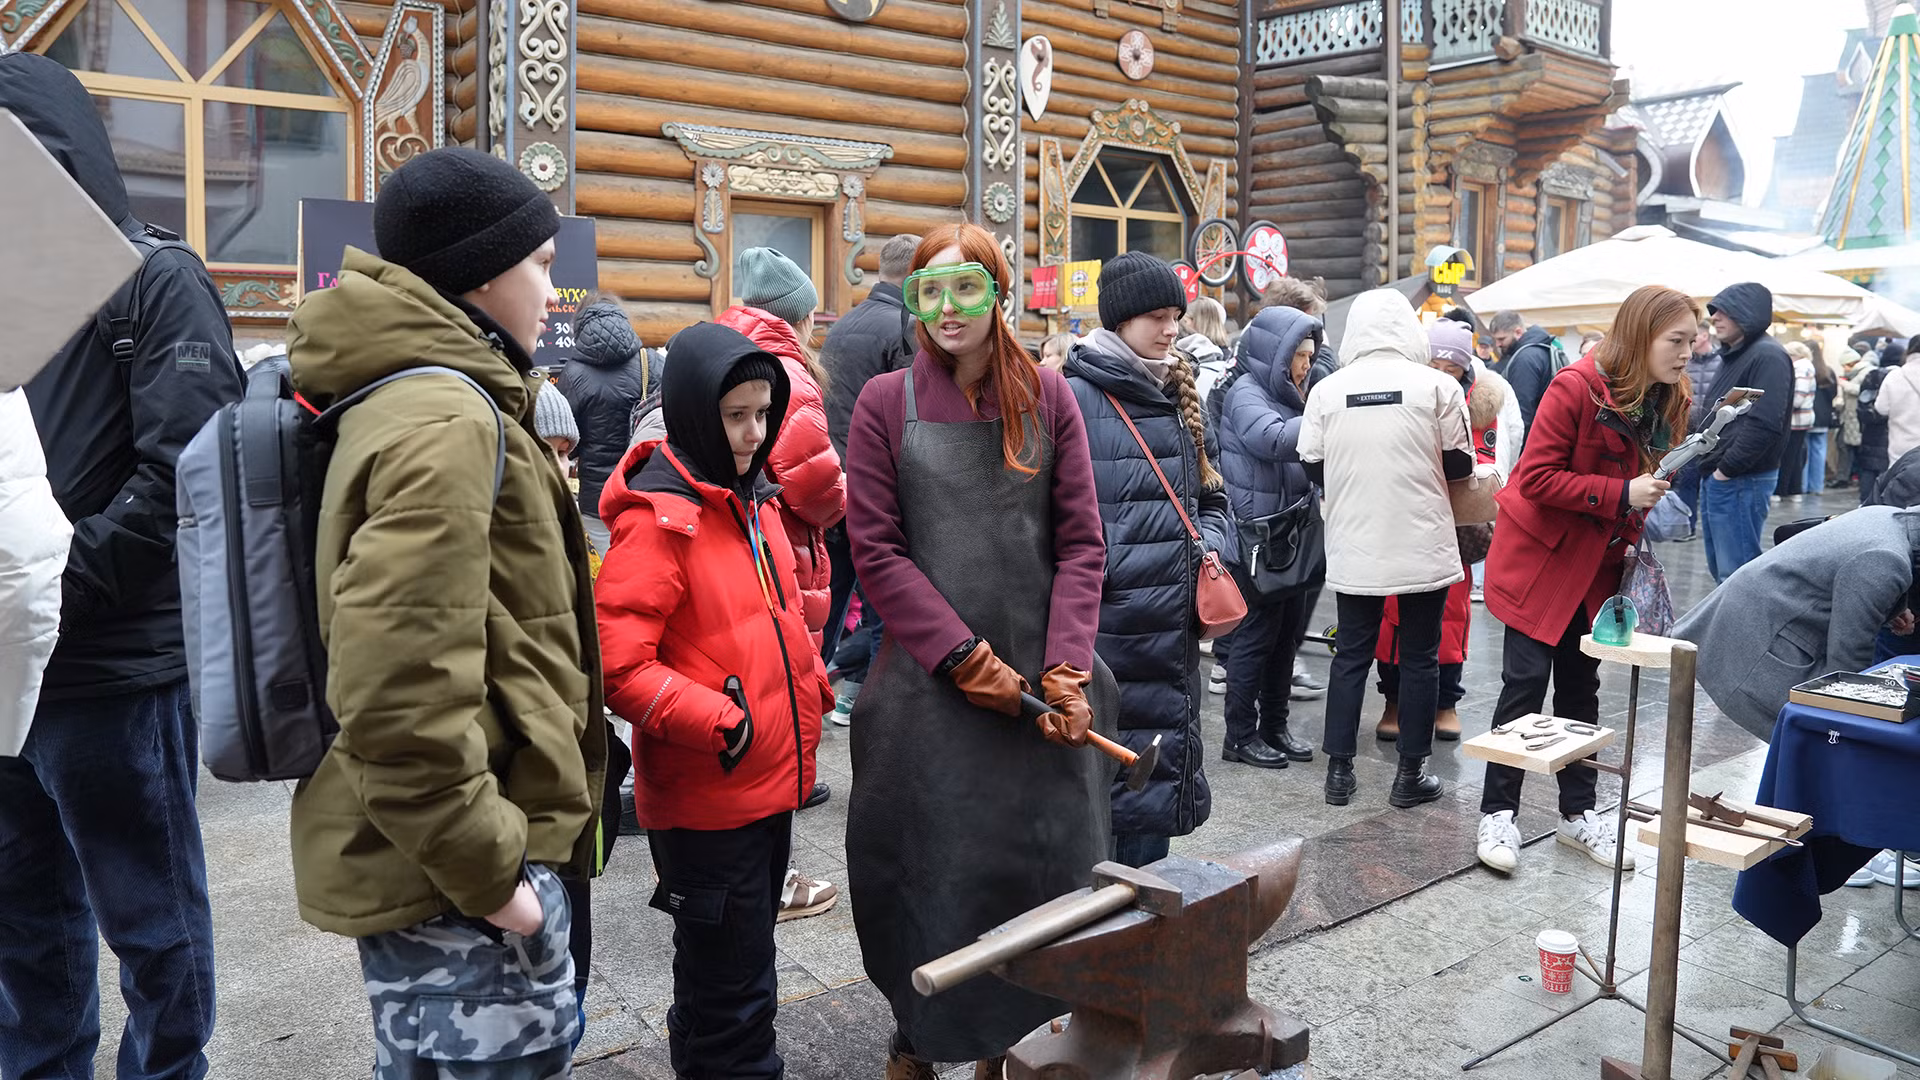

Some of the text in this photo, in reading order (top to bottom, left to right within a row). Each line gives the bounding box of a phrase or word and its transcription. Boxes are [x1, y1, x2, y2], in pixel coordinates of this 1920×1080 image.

[1433, 262, 1466, 284] СЫР
[178, 345, 209, 359] MEN
[1360, 393, 1387, 402] EXTREME
[1884, 679, 1896, 687] 50
